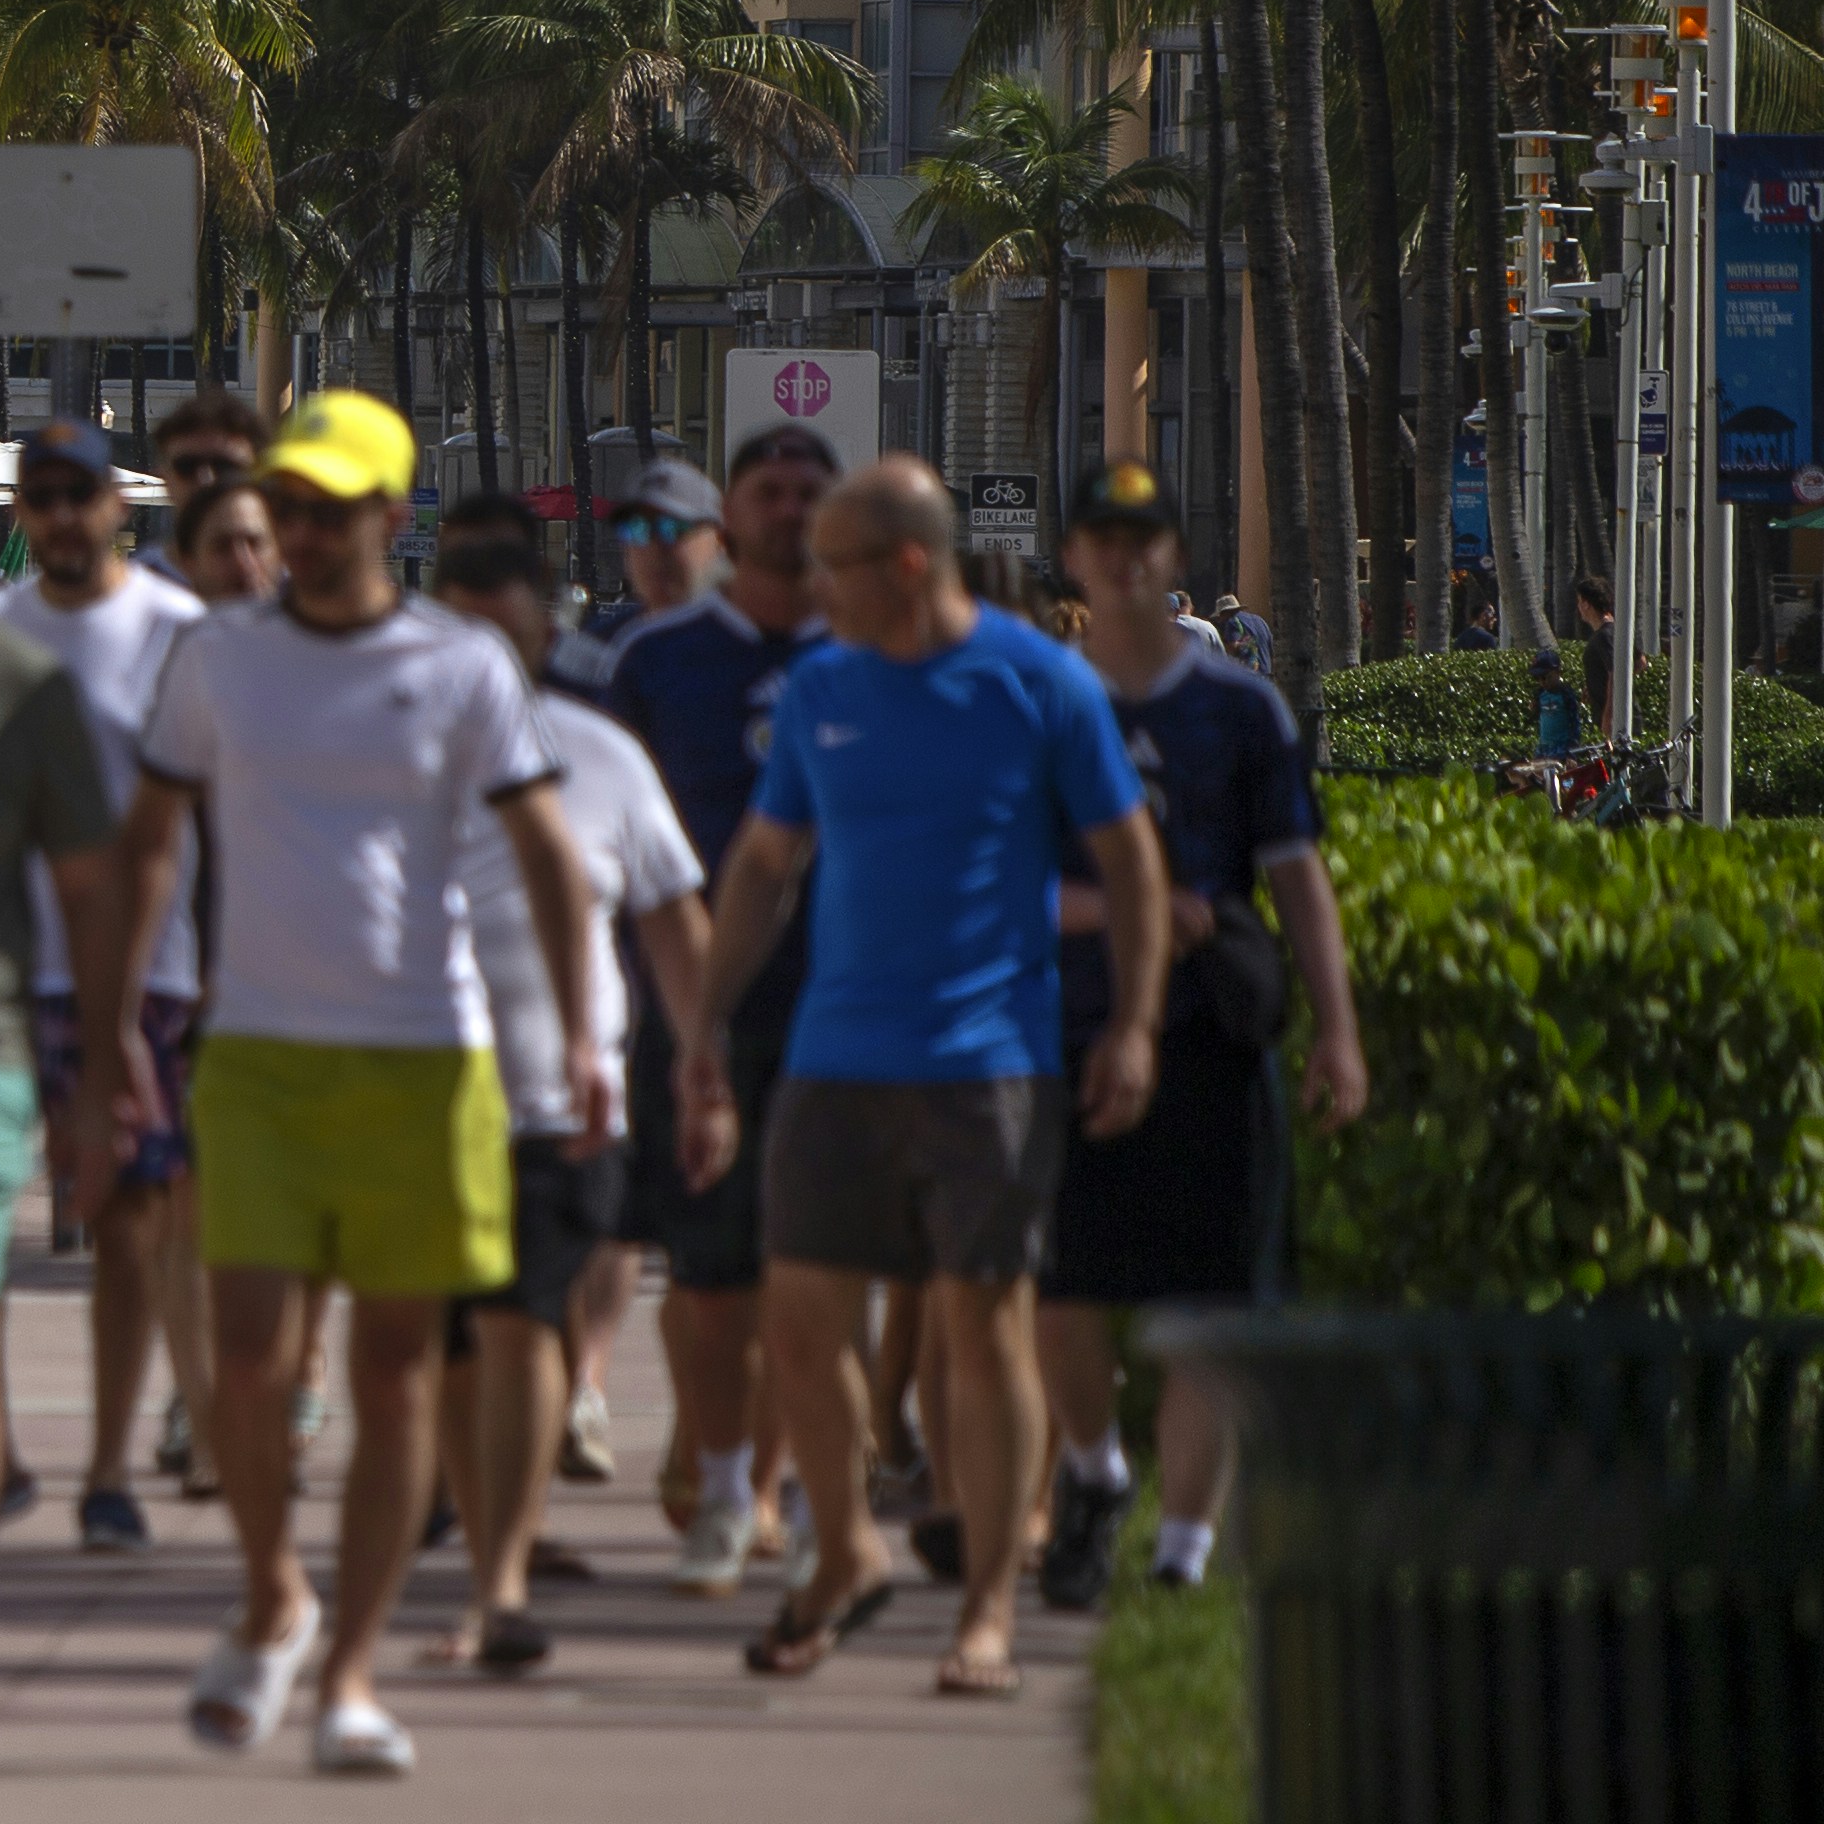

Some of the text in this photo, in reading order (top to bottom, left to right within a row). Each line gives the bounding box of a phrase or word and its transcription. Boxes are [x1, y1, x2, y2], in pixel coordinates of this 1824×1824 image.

[1788, 181, 1811, 206] OF
[1726, 262, 1799, 278] NORTH BEACH
[775, 376, 831, 402] STOP
[973, 511, 1036, 524] BIKE LANE
[398, 540, 436, 552] 88526
[984, 538, 1023, 551] ENDS
